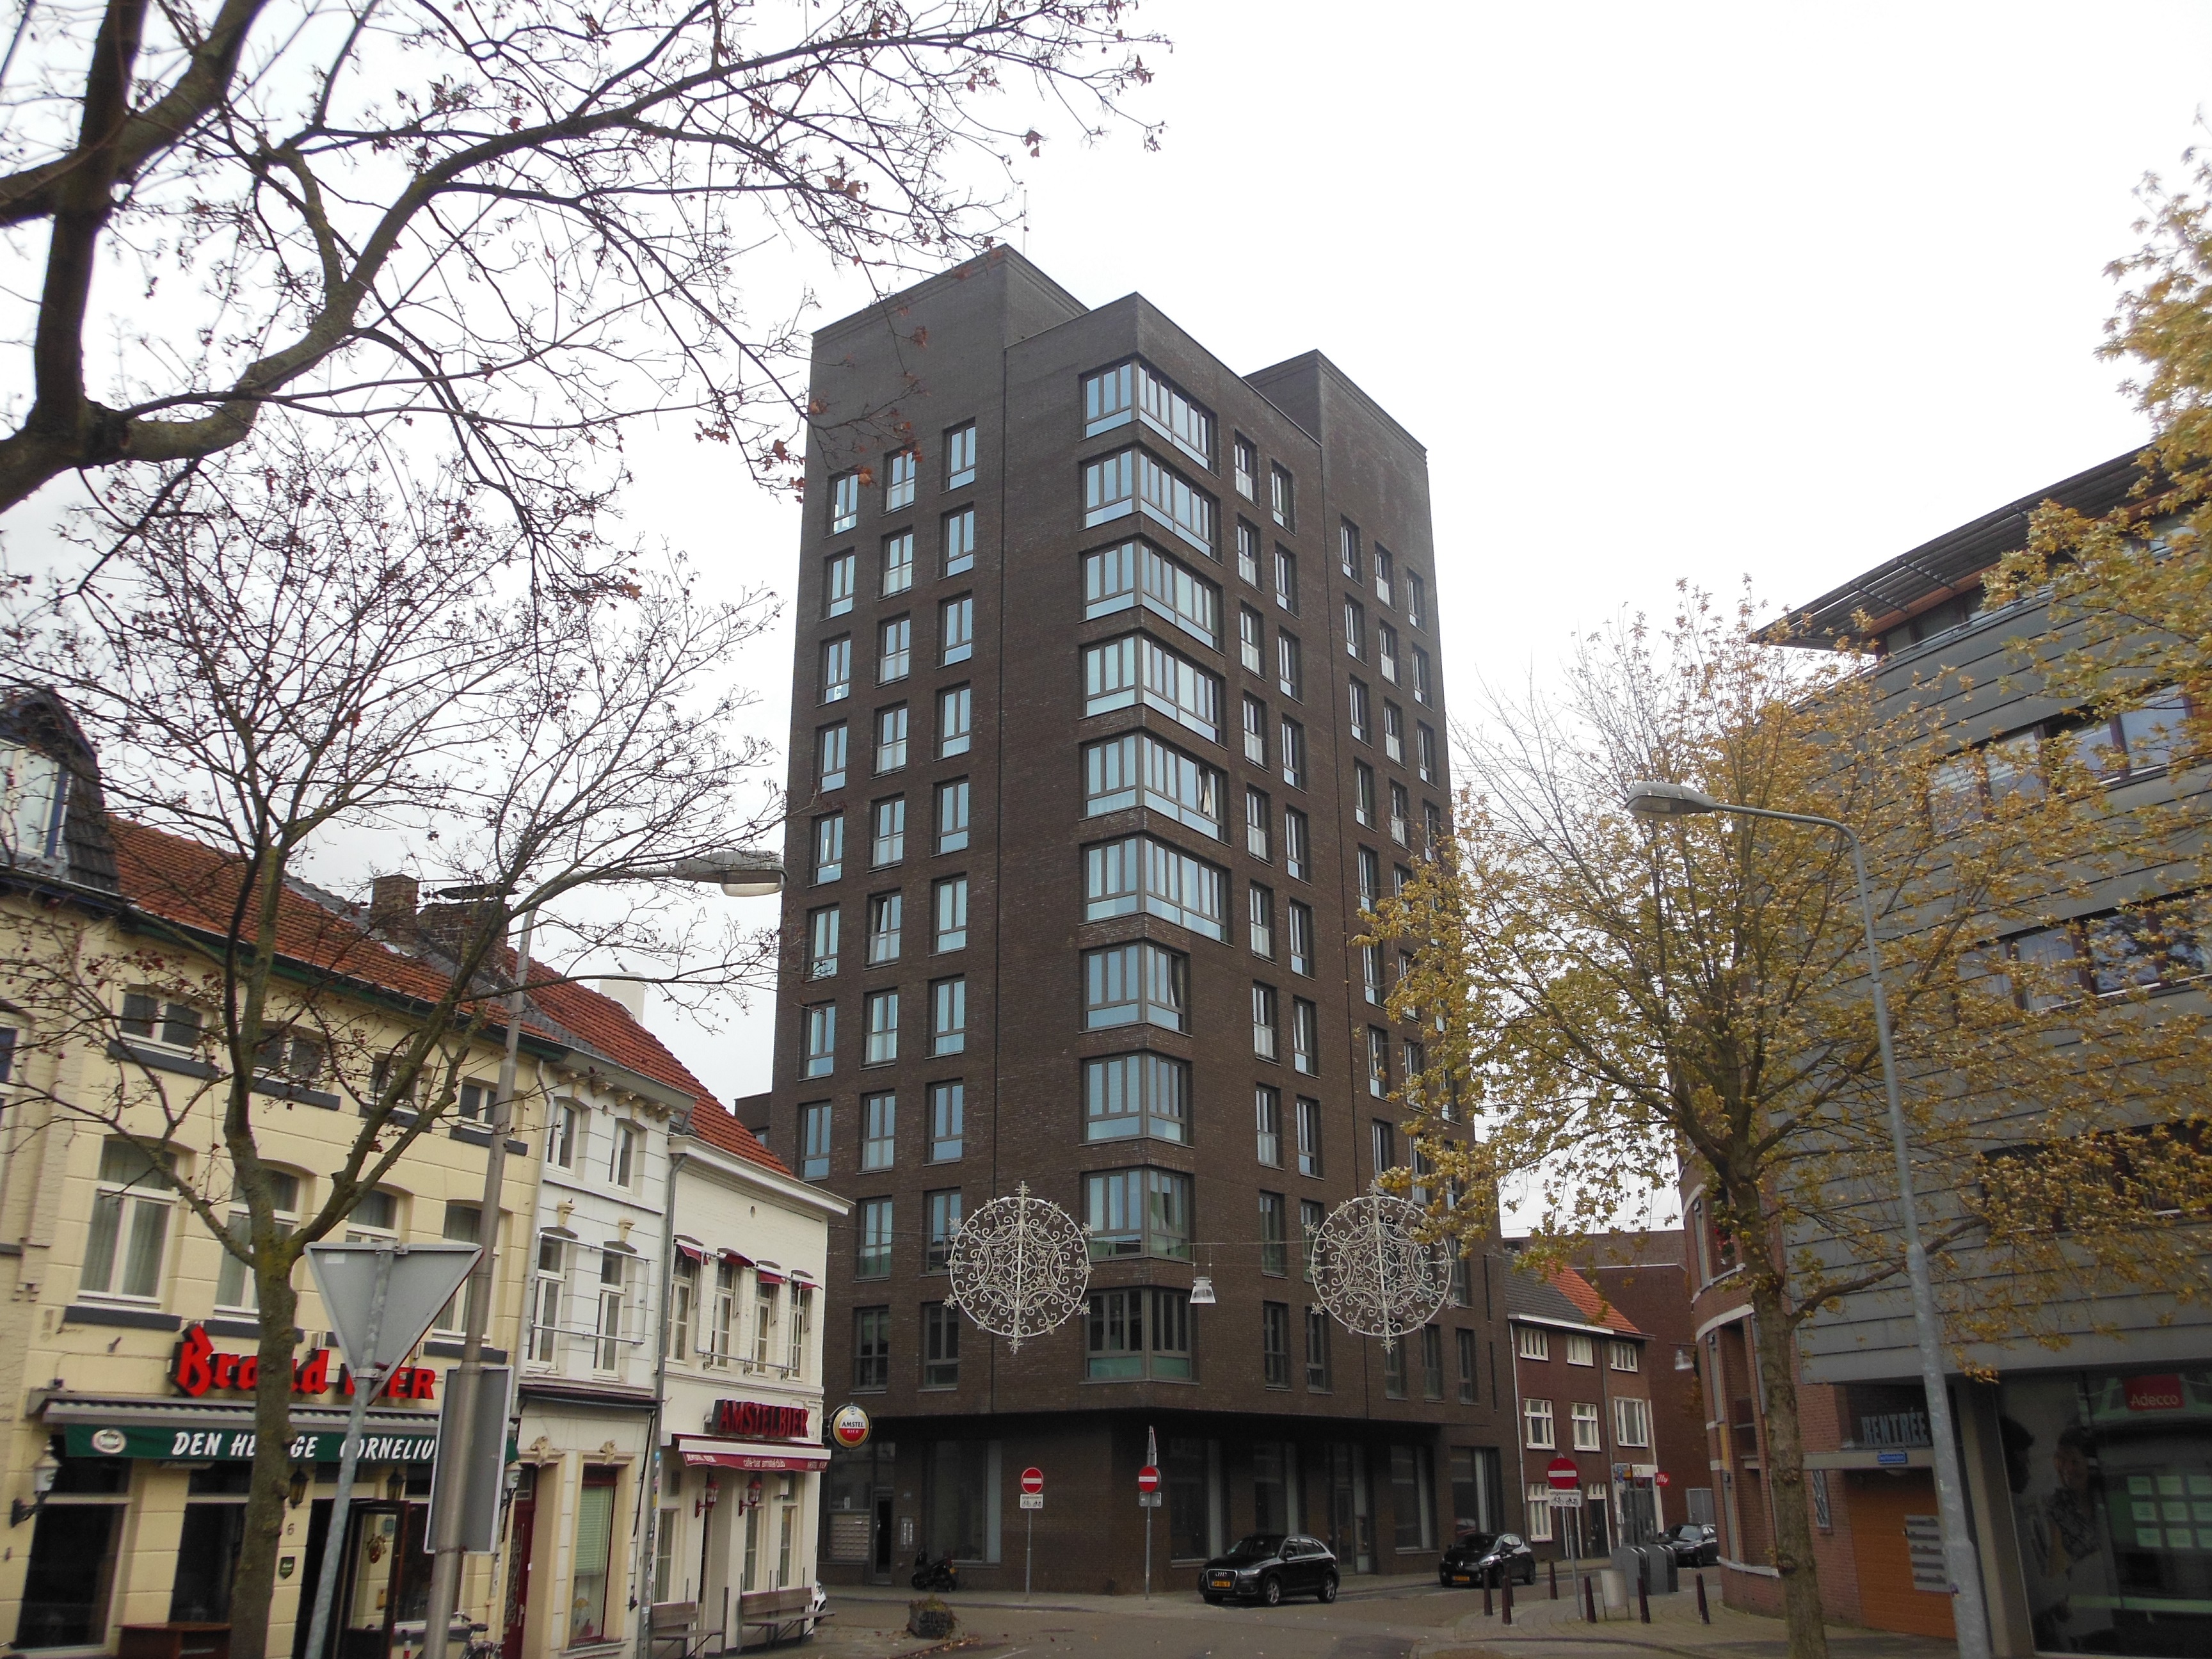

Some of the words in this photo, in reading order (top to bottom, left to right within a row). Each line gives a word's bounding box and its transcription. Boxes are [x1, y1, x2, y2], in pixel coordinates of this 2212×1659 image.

[175, 1324, 330, 1397] Brad
[344, 1364, 436, 1400] ER
[2129, 1393, 2179, 1407] Adecco
[172, 1432, 222, 1457] DEN
[230, 1432, 319, 1459] HEGE
[1656, 1474, 1668, 1484] illy
